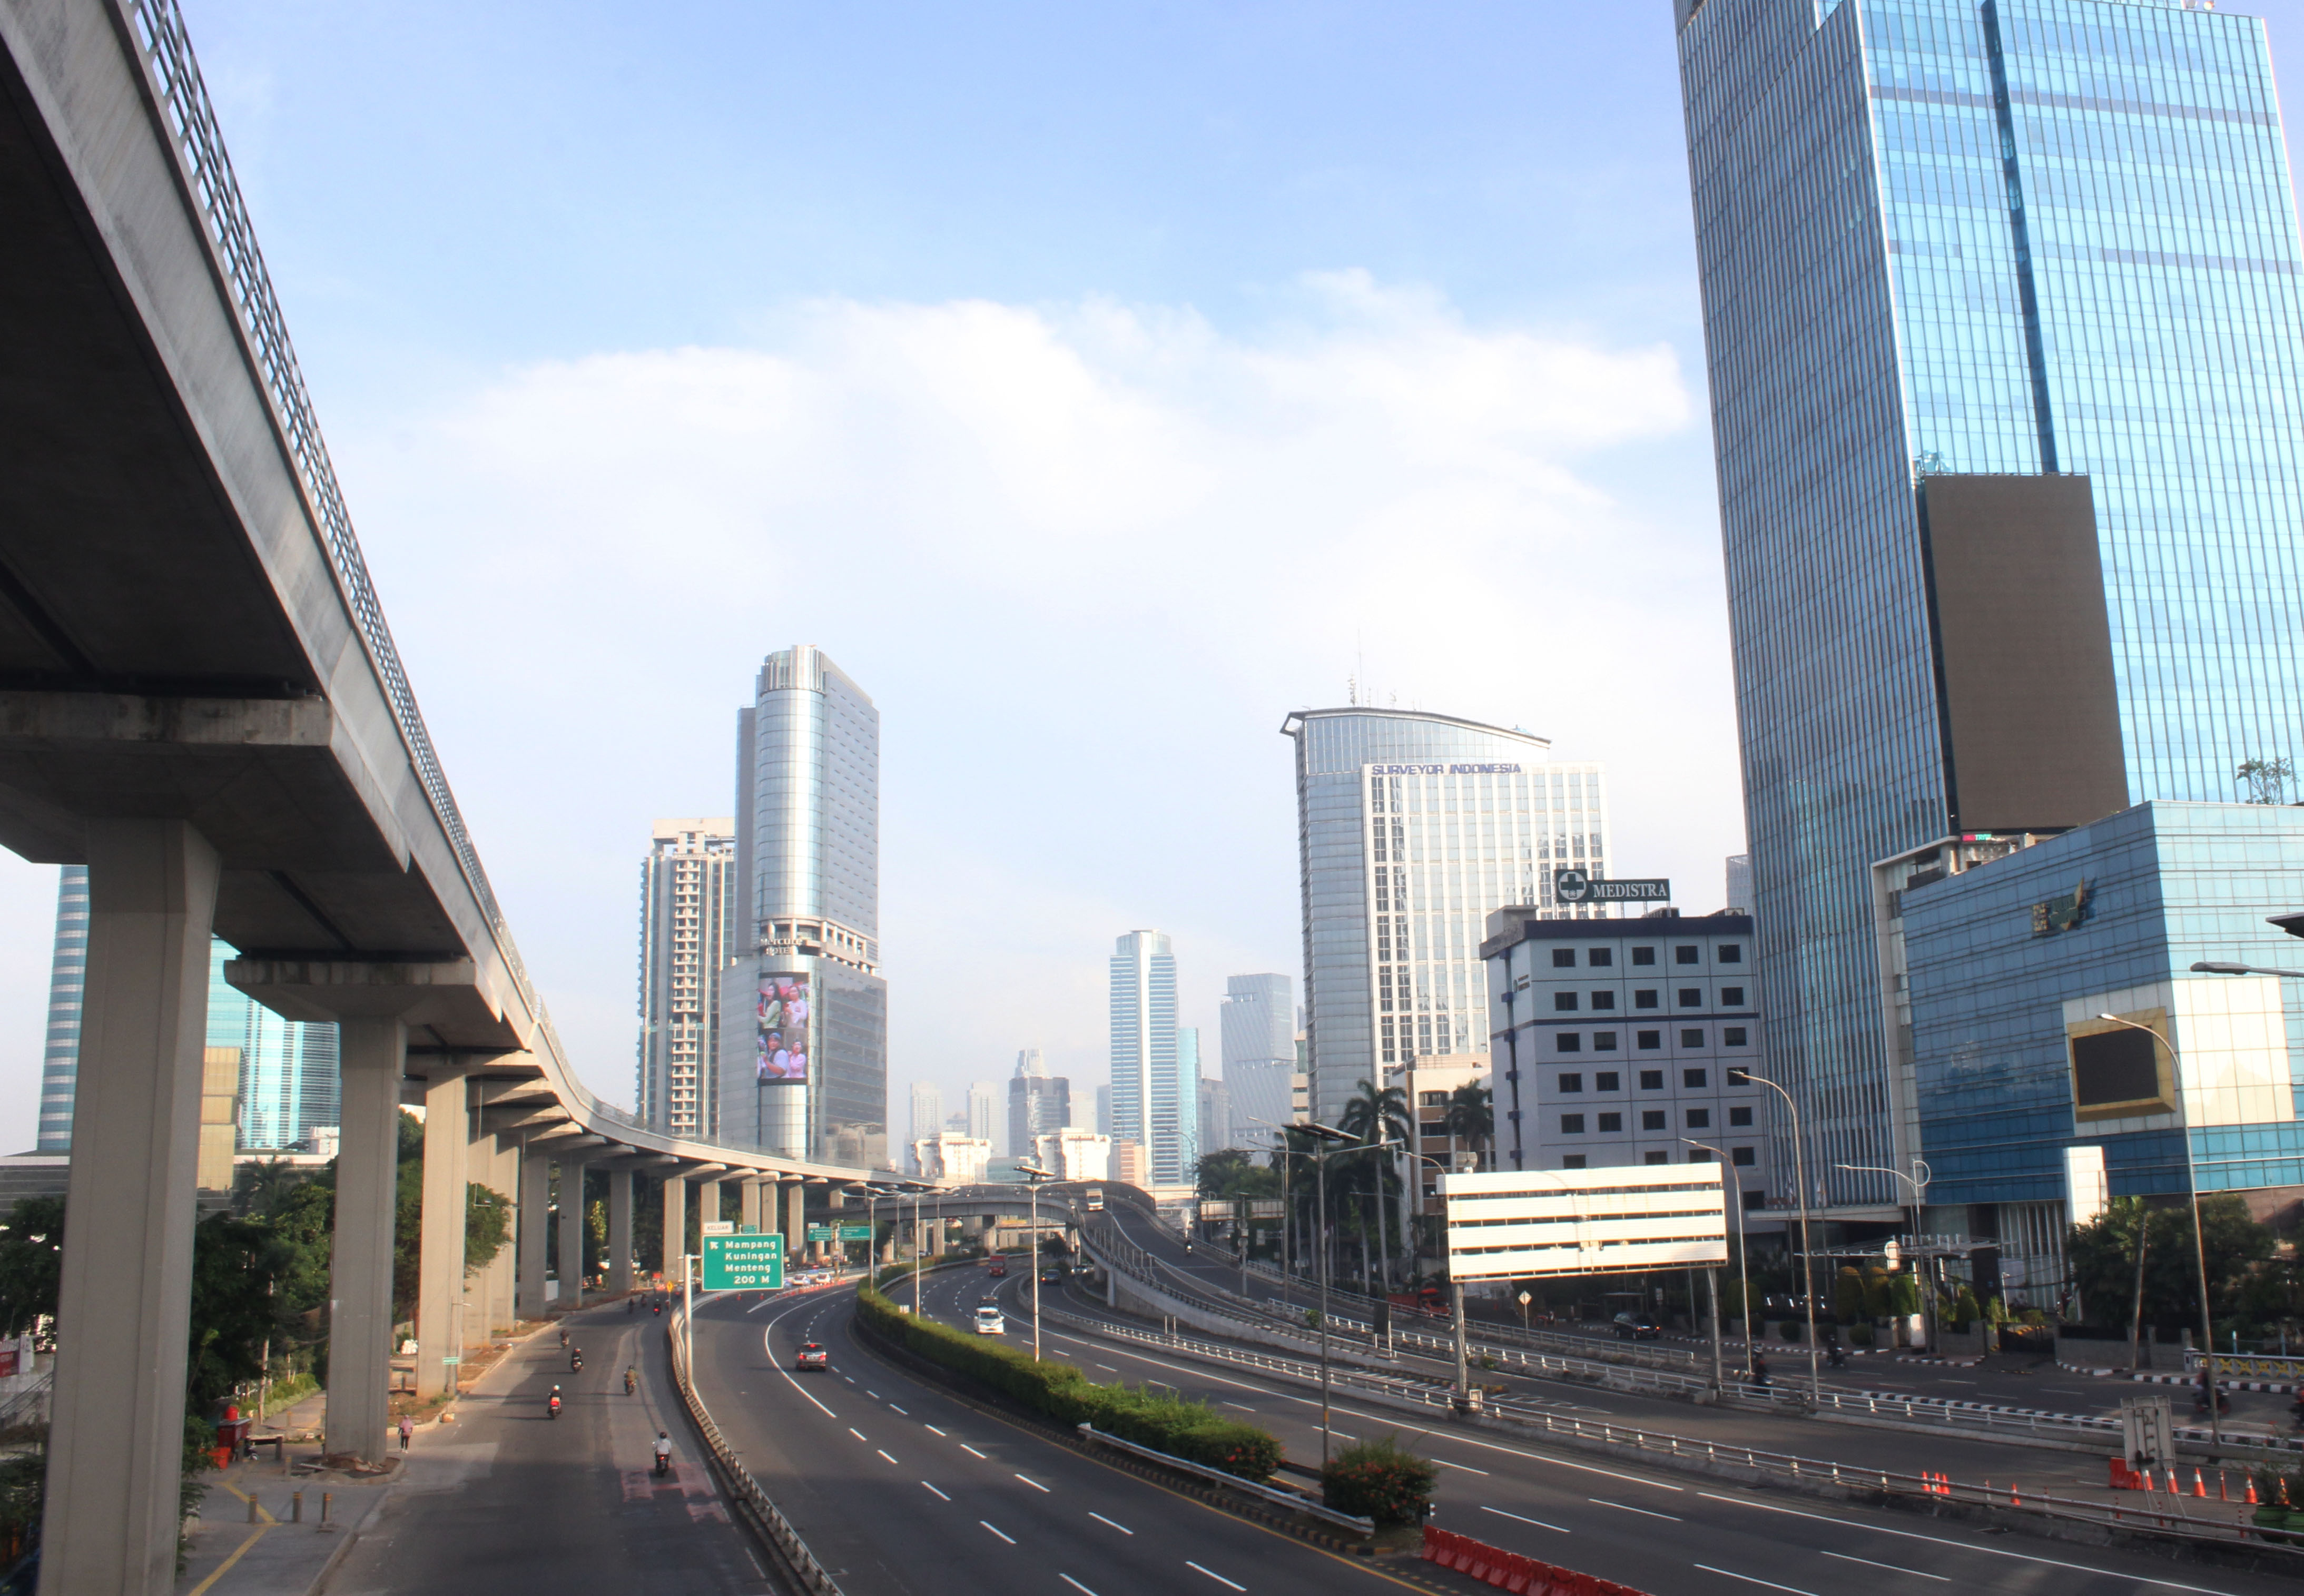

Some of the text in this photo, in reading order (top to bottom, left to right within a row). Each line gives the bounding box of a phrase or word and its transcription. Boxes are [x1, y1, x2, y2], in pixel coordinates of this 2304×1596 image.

[1372, 763, 1521, 775] SURVEYOR INDONESIA
[1593, 883, 1668, 898] MEDISTRA
[760, 938, 803, 947] Mercure
[725, 1240, 776, 1250] Mampang
[725, 1252, 777, 1262] Kuningan
[725, 1264, 771, 1273] Menteng
[734, 1275, 755, 1285] 200
